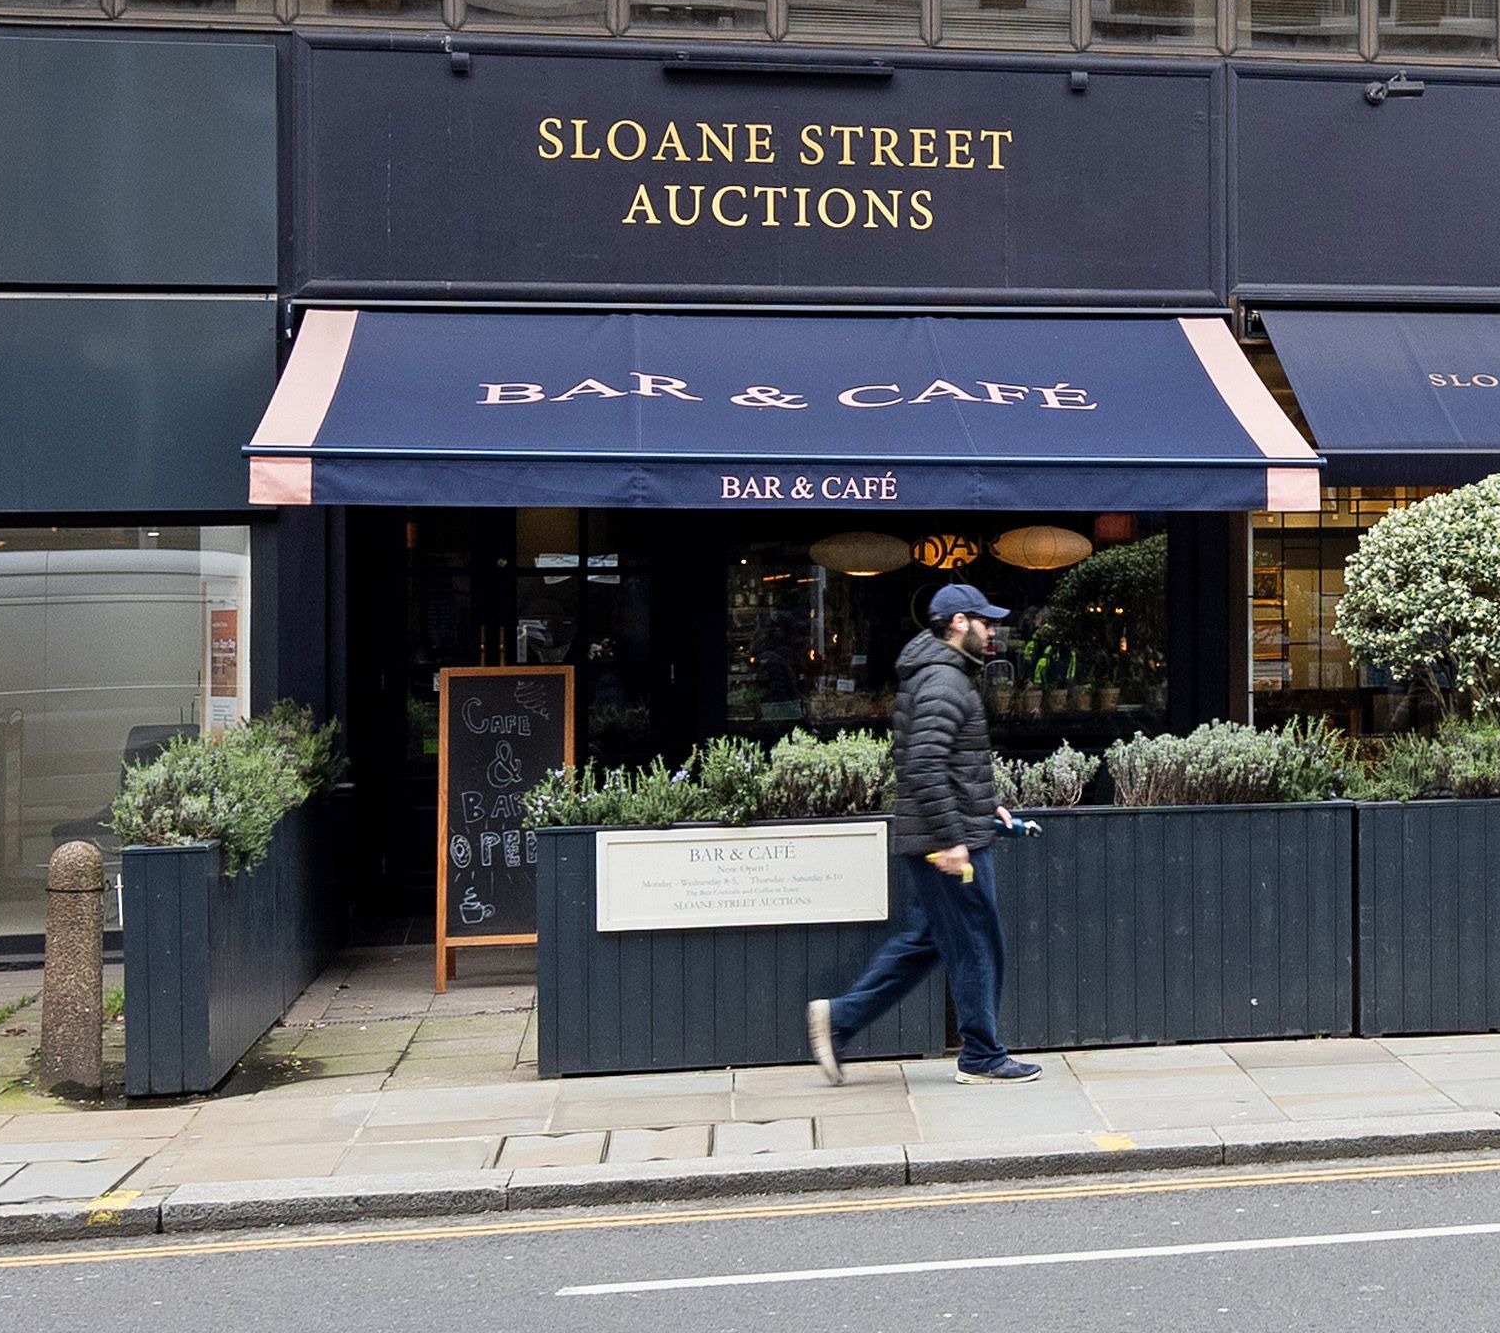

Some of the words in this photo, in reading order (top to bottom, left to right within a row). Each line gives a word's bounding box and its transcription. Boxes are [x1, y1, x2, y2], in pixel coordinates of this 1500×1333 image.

[537, 117, 775, 164] SLOANE
[799, 124, 1013, 170] STREET
[621, 183, 934, 231] AUCTIONS
[475, 371, 704, 405] BAR
[730, 386, 809, 411] &
[837, 379, 1099, 412] CAFÉ
[719, 475, 784, 499] BAR
[789, 476, 816, 499] &
[820, 471, 899, 501] CAFÉ
[486, 739, 522, 789] &
[689, 847, 725, 863] BAR
[730, 848, 743, 861] &
[748, 841, 797, 861] CAFÉ
[673, 900, 715, 911] SLOANE
[717, 898, 755, 910] STREET
[758, 896, 812, 908] AUCTIONS
